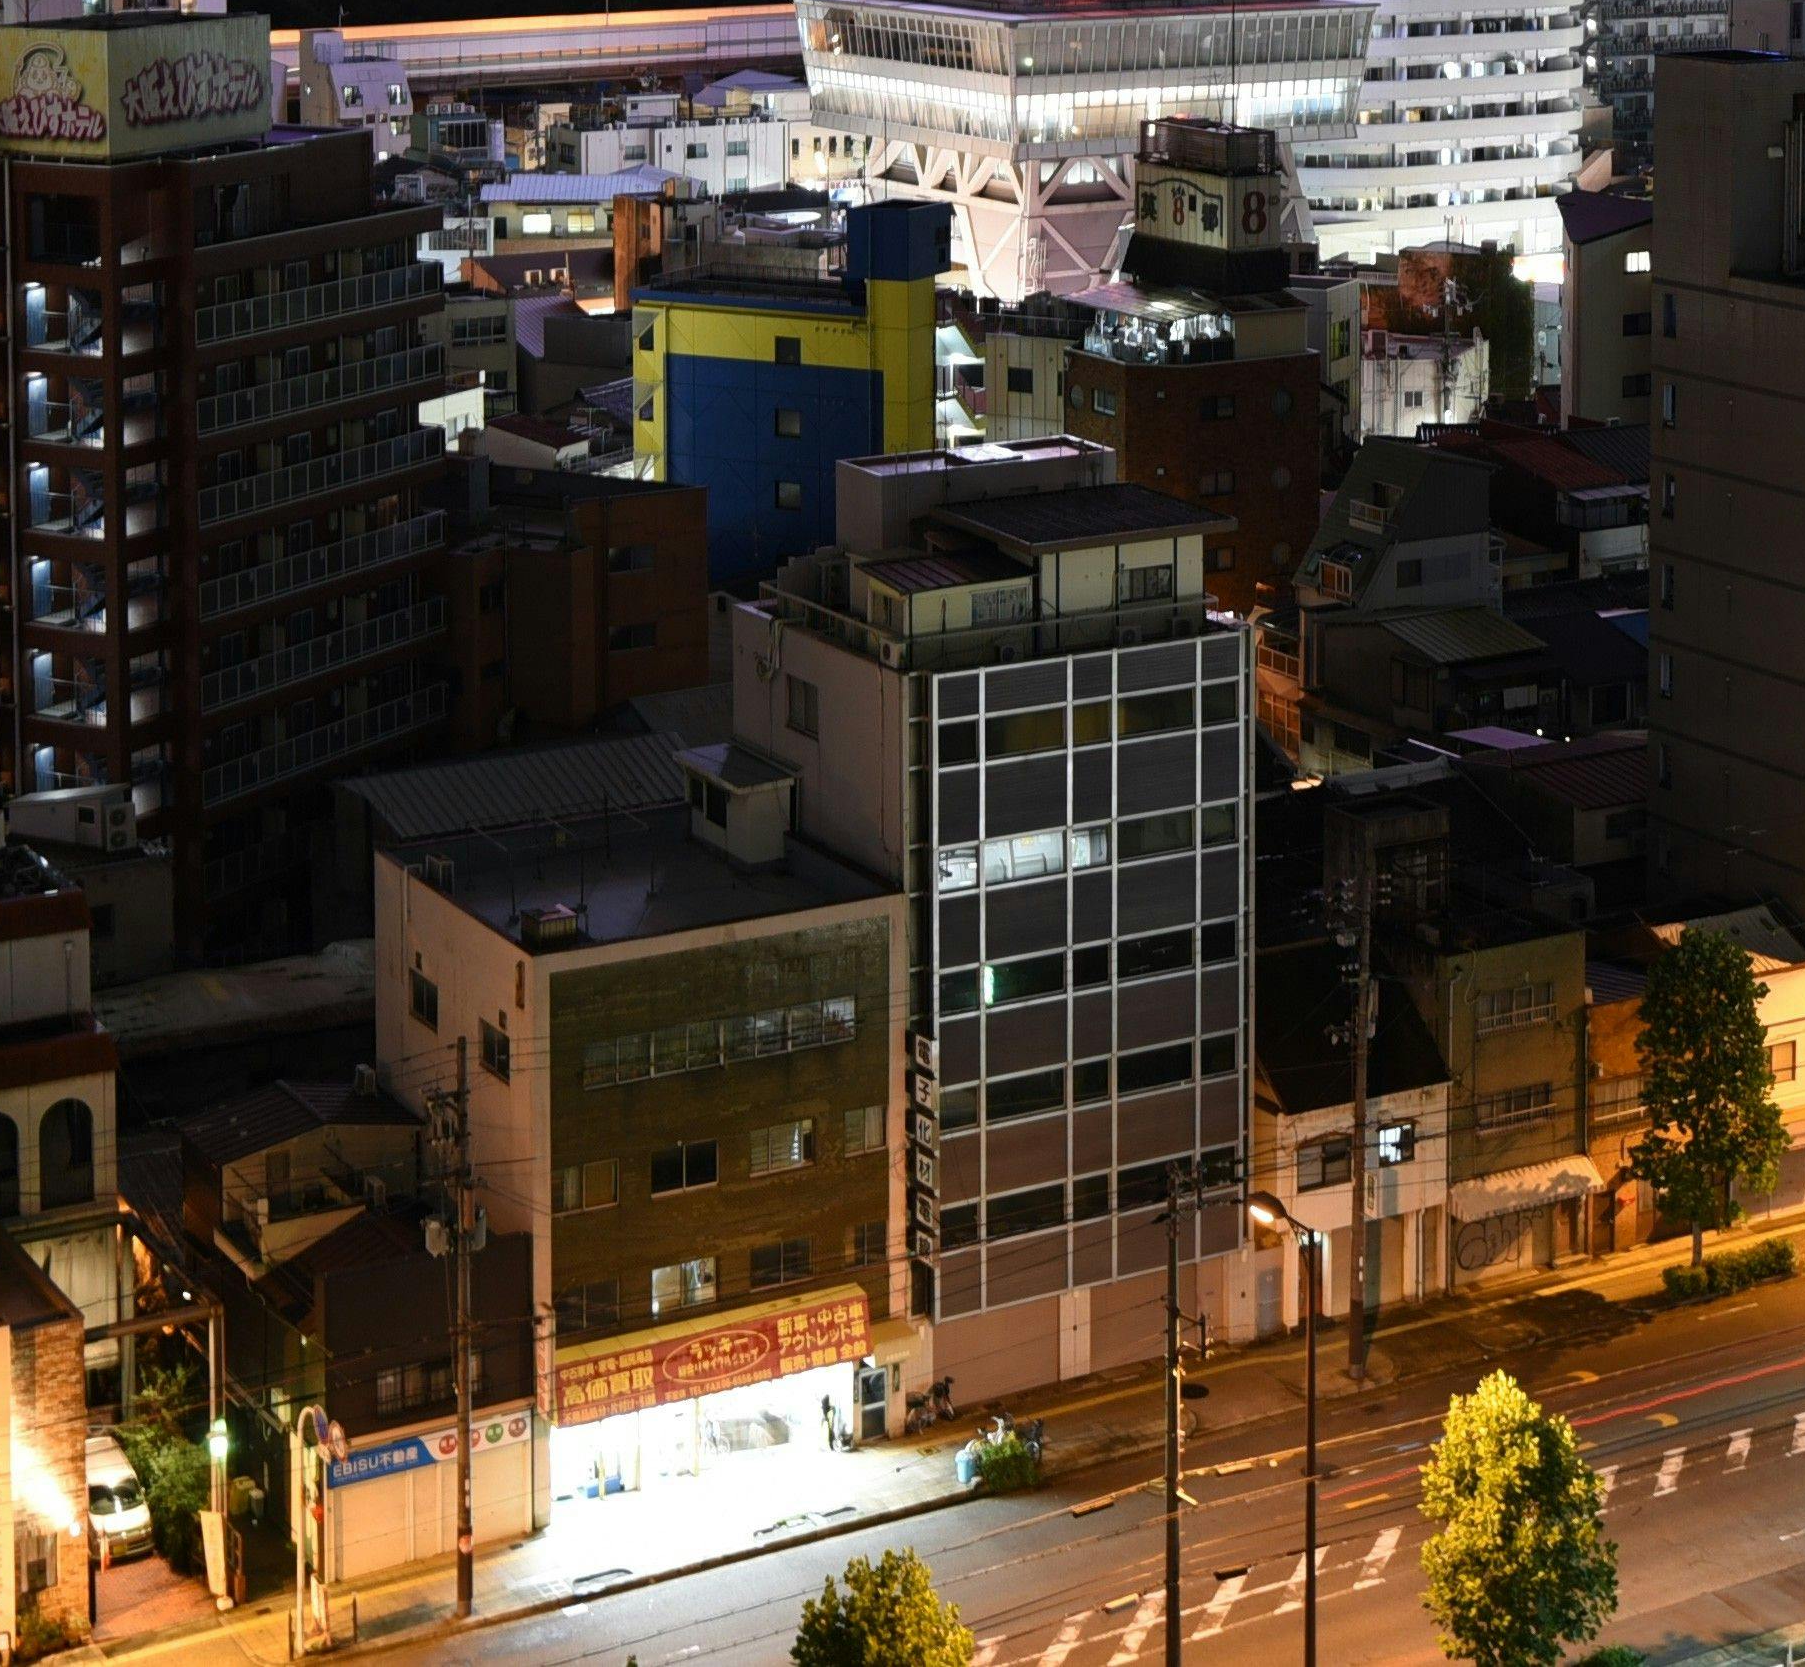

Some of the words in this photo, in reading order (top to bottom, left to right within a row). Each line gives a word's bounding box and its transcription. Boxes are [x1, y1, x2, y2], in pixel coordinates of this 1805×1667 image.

[122, 50, 263, 126] 大阪えびすホテル
[1242, 191, 1267, 235] 8
[689, 1336, 749, 1361] ラッキー
[563, 1365, 655, 1407] 高価買取
